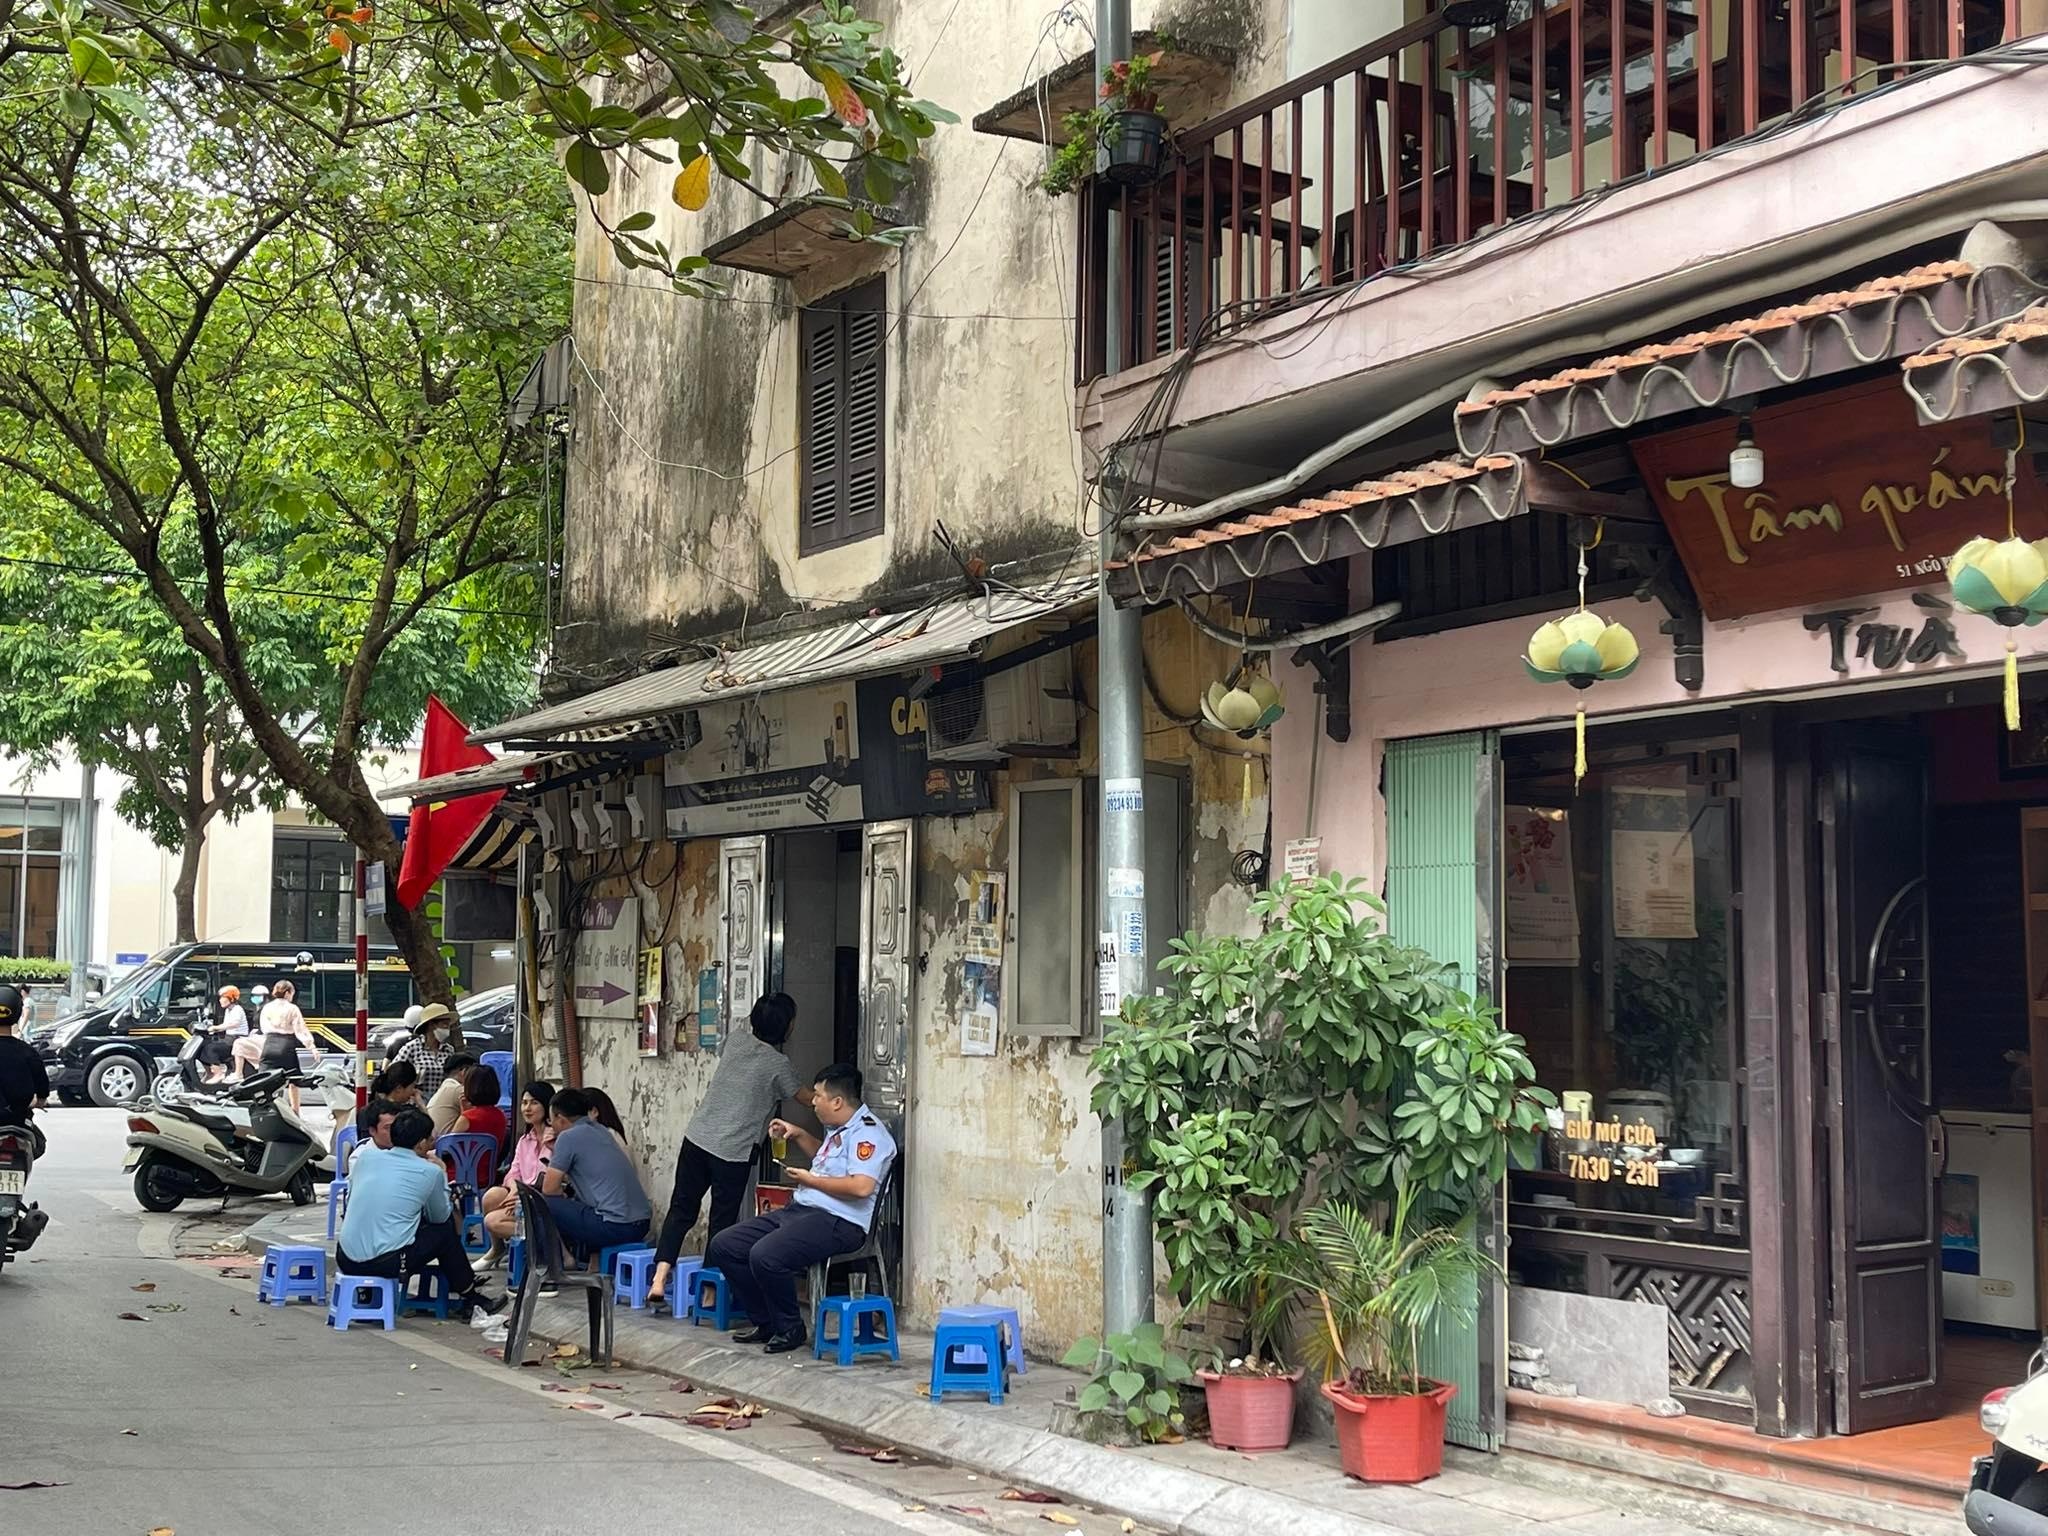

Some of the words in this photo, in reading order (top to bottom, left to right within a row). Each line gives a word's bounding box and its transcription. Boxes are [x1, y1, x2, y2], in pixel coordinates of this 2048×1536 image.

[1665, 472, 1843, 564] Tâm
[1860, 448, 2006, 551] quán
[1595, 1114, 1621, 1143] MỞ
[1624, 1117, 1657, 1147] CỬA
[1567, 1153, 1610, 1182] 7h30
[1625, 1160, 1659, 1188] 23h
